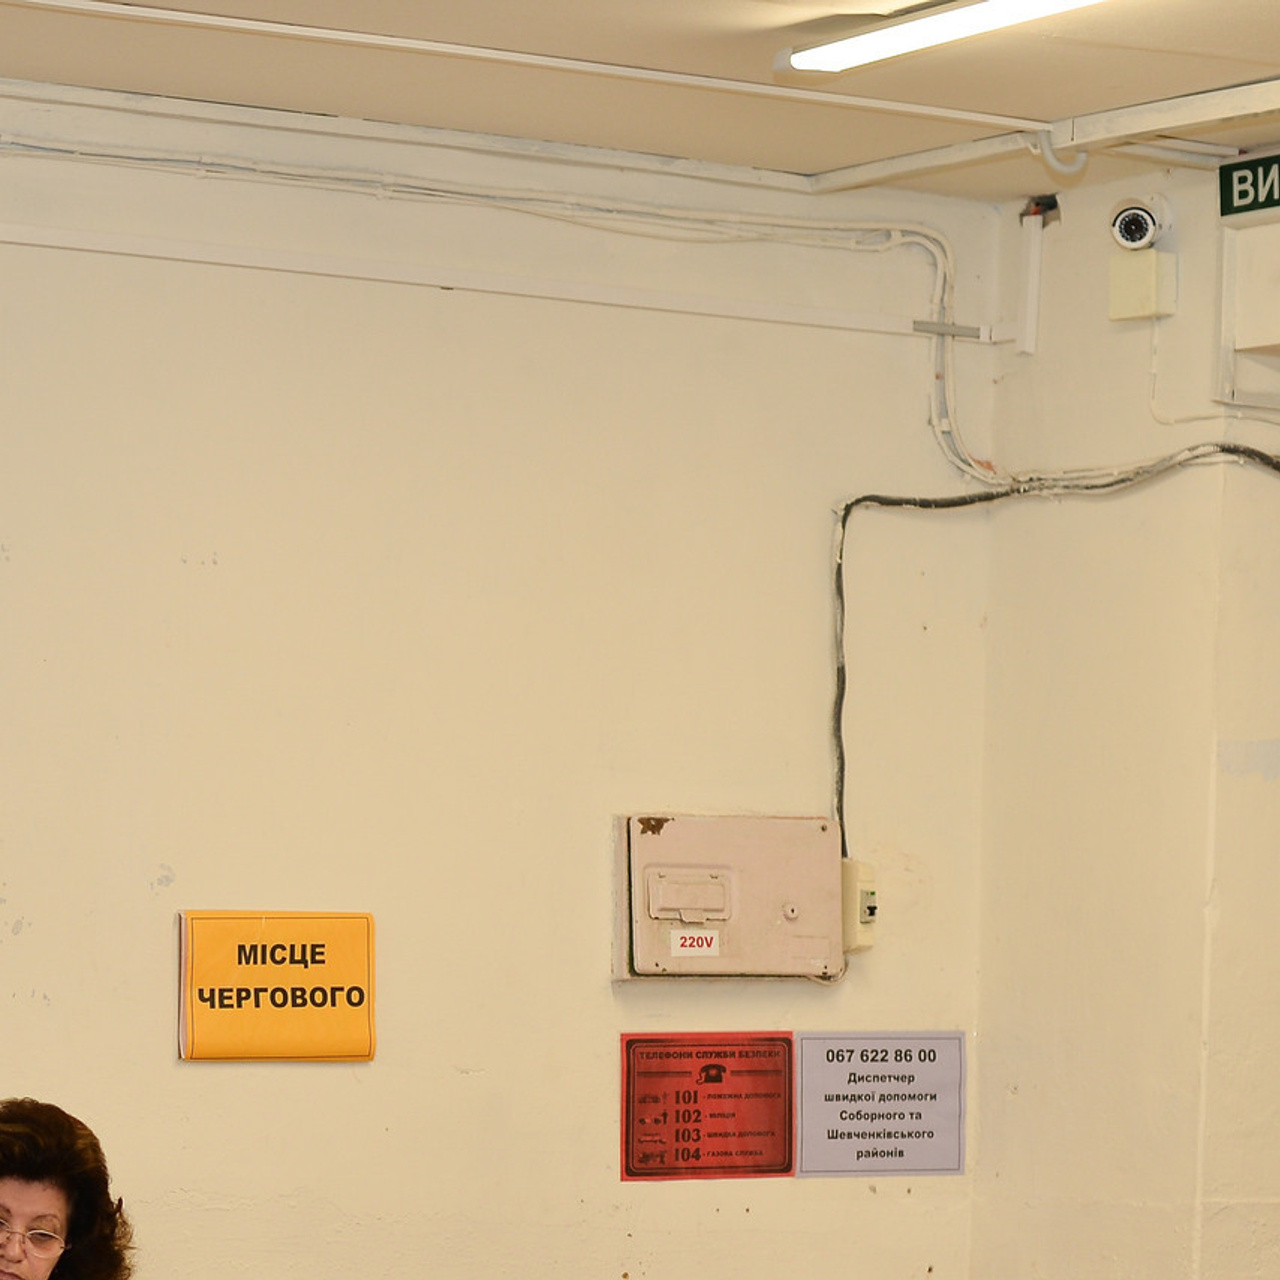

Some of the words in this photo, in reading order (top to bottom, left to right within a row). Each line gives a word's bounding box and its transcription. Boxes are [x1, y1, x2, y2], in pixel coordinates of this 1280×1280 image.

[679, 936, 714, 948] 220V
[237, 944, 326, 968] МІСЦЕ
[198, 986, 365, 1009] ЧЕРГОВОГО
[639, 1051, 693, 1060] ТЕЛЕФОНИ
[696, 1051, 736, 1060] СЛУЖБИ
[739, 1050, 781, 1059] БЕЗПЕКИ
[826, 1049, 855, 1063] 067
[860, 1049, 889, 1063] 622
[894, 1049, 913, 1063] 86
[918, 1049, 937, 1063] 00
[847, 1072, 915, 1085] Диспетчер
[674, 1090, 699, 1104] 101
[824, 1091, 876, 1103] швидкої
[878, 1093, 937, 1103] допомоги
[674, 1109, 702, 1124] 102
[839, 1110, 906, 1123] Соборного
[909, 1112, 922, 1121] та
[674, 1128, 702, 1143] 103
[827, 1128, 935, 1140] Шевченківського
[674, 1147, 702, 1162] 104
[856, 1147, 905, 1160] районів
